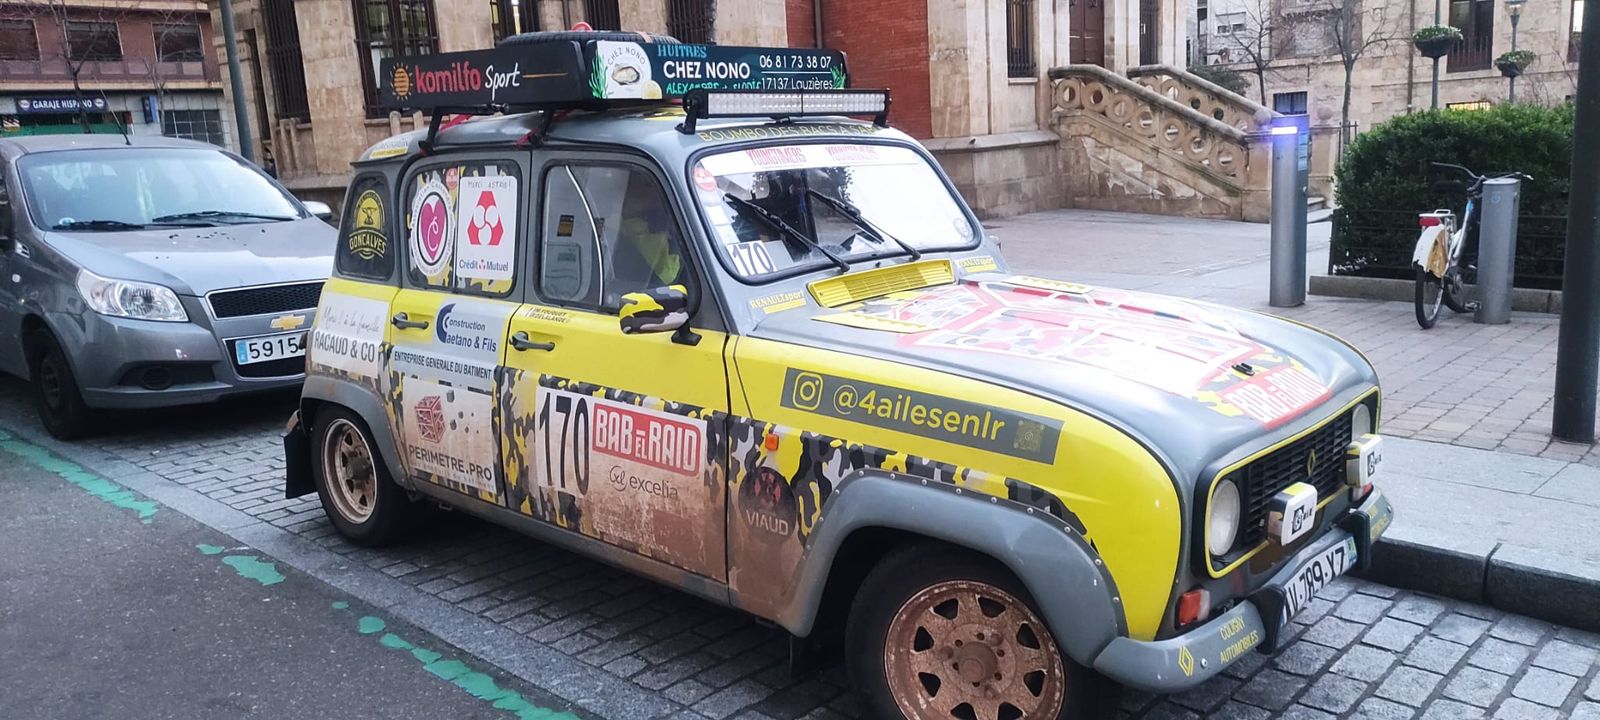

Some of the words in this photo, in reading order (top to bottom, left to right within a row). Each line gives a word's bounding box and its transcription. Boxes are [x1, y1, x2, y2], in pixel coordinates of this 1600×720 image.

[607, 48, 623, 65] CHEZ
[625, 46, 646, 65] NONO
[657, 44, 707, 58] HUITRES
[759, 55, 772, 68] 06
[775, 55, 787, 68] 81
[791, 55, 803, 68] 73
[806, 55, 818, 68] 38
[820, 56, 832, 68] 07
[415, 61, 481, 94] komilfo
[484, 62, 521, 100] Sport
[663, 60, 701, 79] CHEZ
[705, 62, 750, 79] NONO
[761, 77, 788, 90] 17137
[32, 100, 60, 109] GARAJE
[62, 99, 92, 108] HISPNO
[700, 126, 767, 142] BOUMBO
[769, 125, 798, 138] DES
[799, 124, 835, 136] BACS
[459, 260, 478, 270] Crédit
[487, 261, 509, 271] Mutuel
[732, 242, 775, 276] 170
[314, 331, 349, 356] RACAUD
[350, 340, 358, 359] &
[361, 342, 375, 363] CO
[473, 335, 480, 349] &
[482, 337, 497, 353] Fils
[394, 350, 425, 367] ENTREPRISE
[426, 356, 454, 373] GENERALE
[455, 362, 463, 374] DU
[463, 364, 492, 380] BATIMENT
[833, 384, 1006, 442] @4ailesenlr
[539, 391, 590, 496] 170
[595, 407, 634, 456] BAB
[635, 436, 648, 460] EL
[648, 420, 698, 472] RAID
[408, 444, 493, 481] PERIMETRE.PRO
[629, 475, 678, 499] excelia
[745, 509, 789, 536] VIAUD
[1220, 615, 1246, 641] COLIGNY
[1220, 629, 1259, 665] AUTOMOBILES
